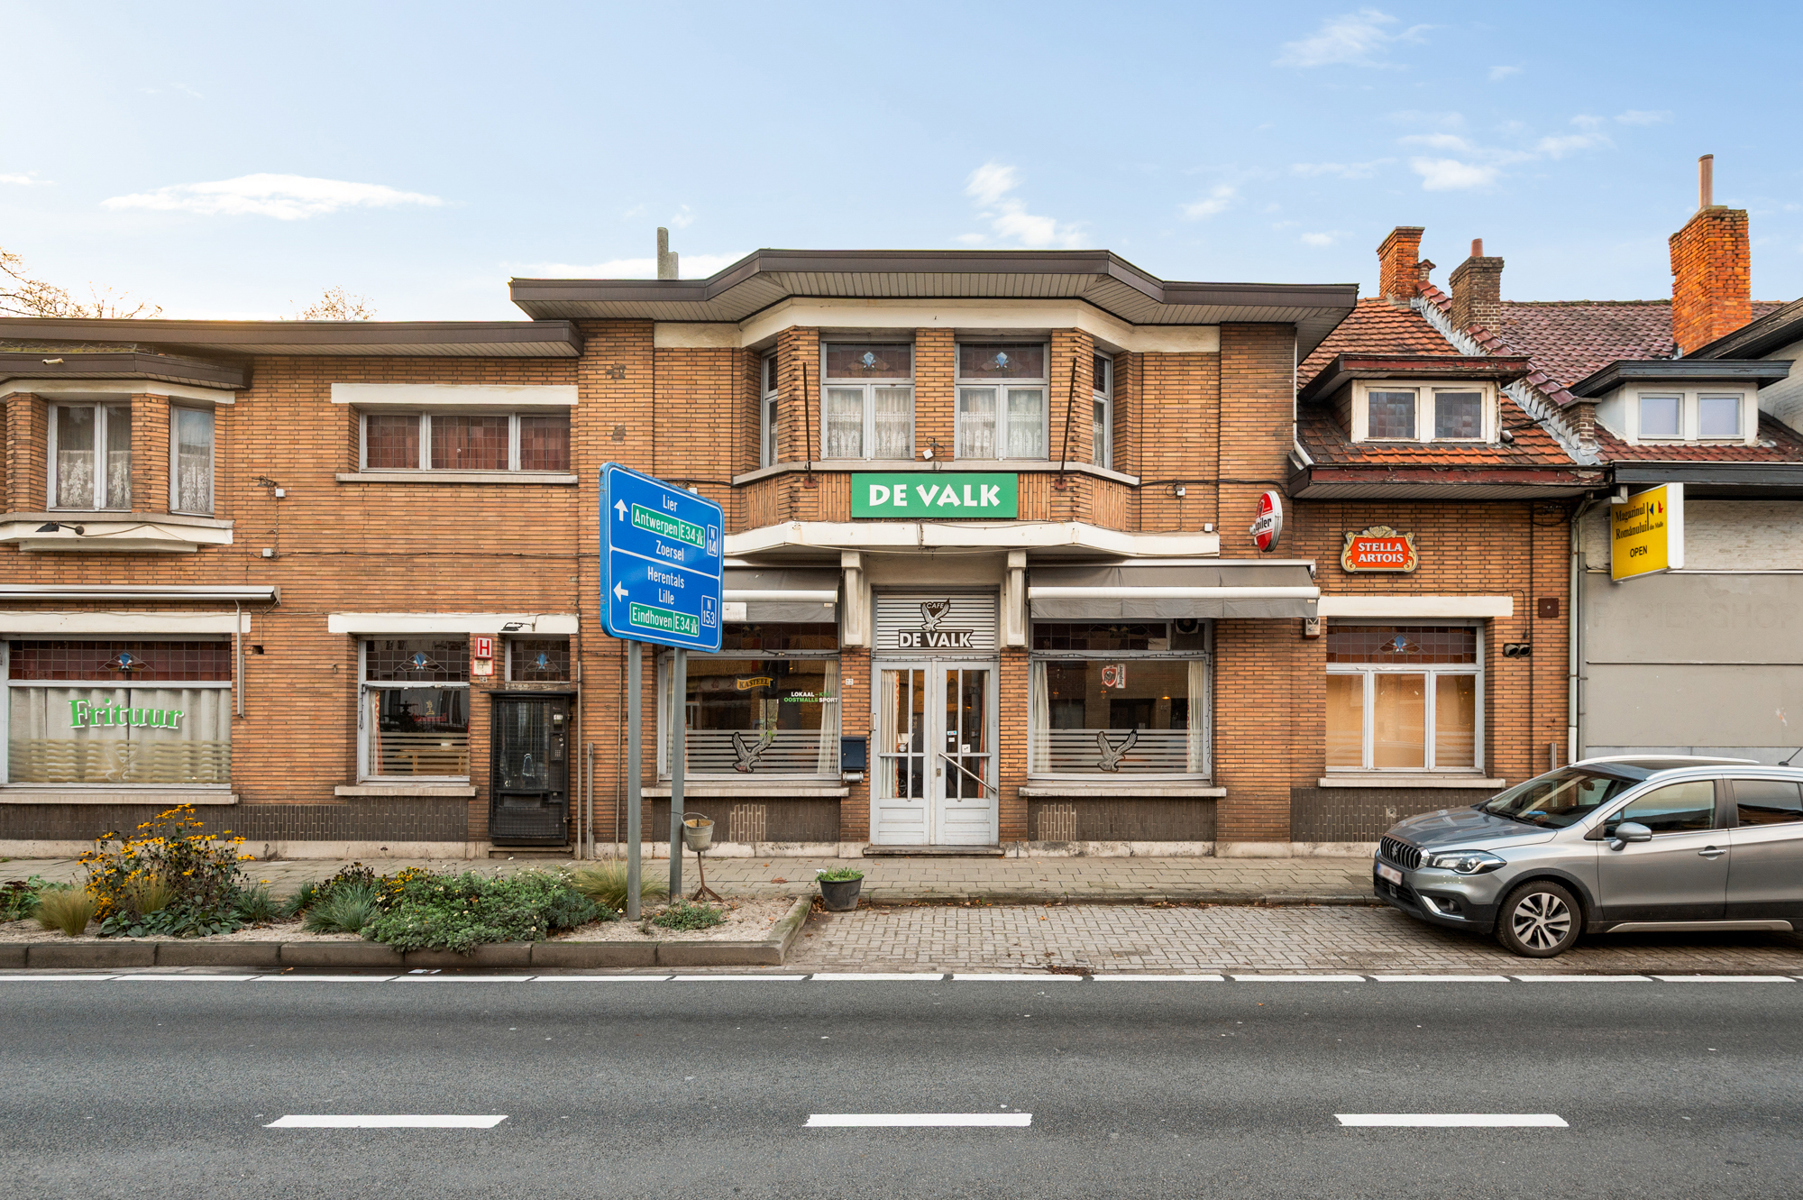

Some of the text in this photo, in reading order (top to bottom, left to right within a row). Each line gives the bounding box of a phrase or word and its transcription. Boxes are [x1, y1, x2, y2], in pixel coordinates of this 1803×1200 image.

[662, 494, 678, 512] Lier
[869, 483, 1001, 507] DE VALK
[1615, 502, 1646, 523] Magazinul
[634, 508, 696, 541] Antwerpen E34
[710, 528, 716, 540] N
[655, 539, 685, 561] Zoersel
[708, 540, 717, 554] 14
[1358, 542, 1404, 552] STELLA
[1629, 545, 1648, 558] OPEN
[1358, 553, 1404, 563] ARTOIS
[647, 565, 685, 589] Herentals
[658, 588, 675, 605] Lille
[707, 599, 712, 610] N
[632, 606, 690, 632] Eindhoven E34
[703, 610, 715, 625] 153
[479, 639, 490, 656] H
[899, 632, 971, 647] DE VALK
[739, 678, 768, 688] KASTEEL
[68, 698, 185, 729] Frituur
